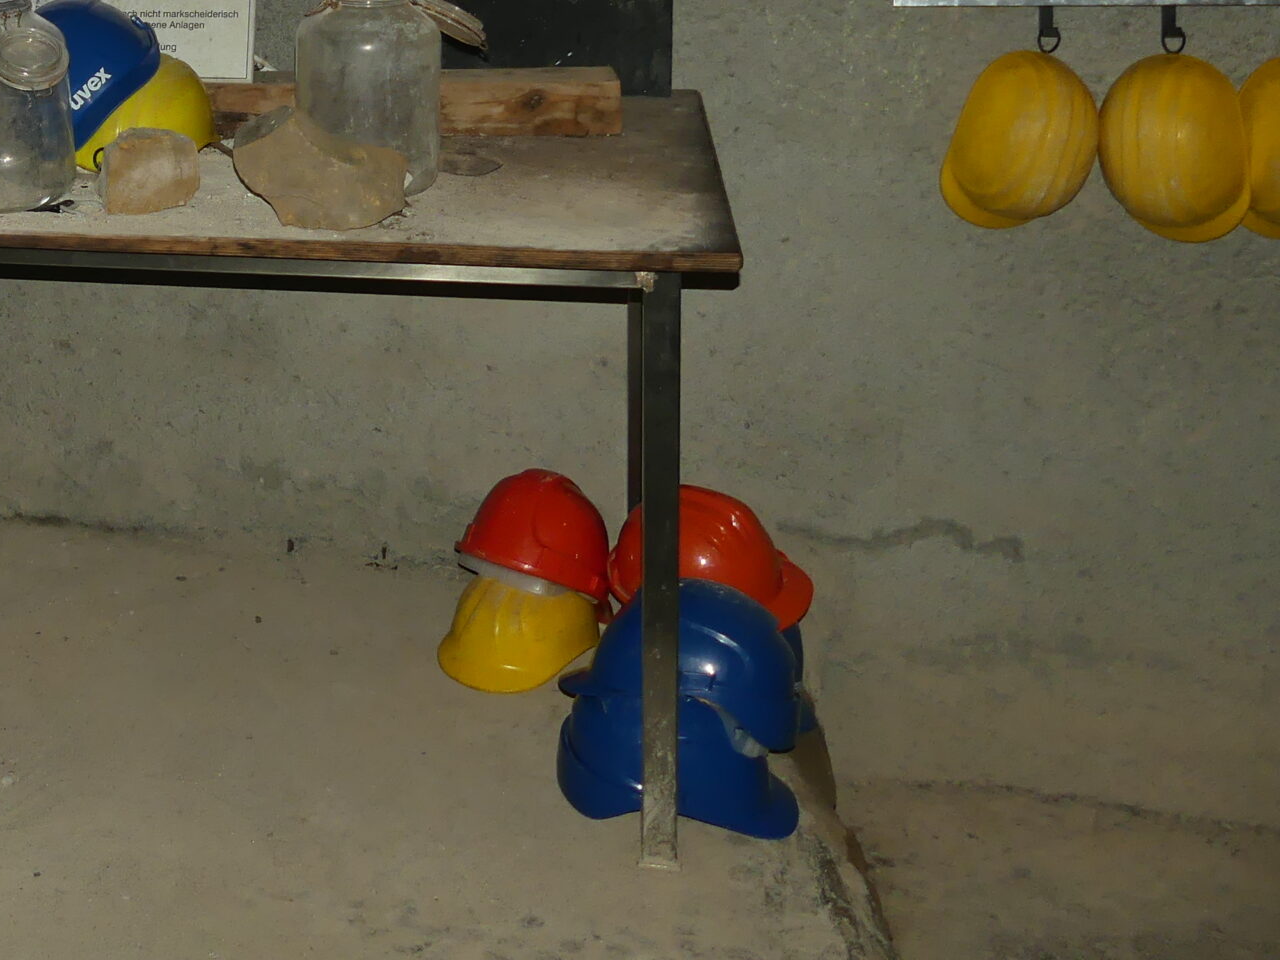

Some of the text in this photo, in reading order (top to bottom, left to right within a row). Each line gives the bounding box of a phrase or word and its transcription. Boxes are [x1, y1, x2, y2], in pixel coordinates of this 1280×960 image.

[140, 10, 161, 18] nicht
[163, 10, 239, 18] markscheiderisch
[169, 20, 206, 31] Anlagen
[70, 66, 113, 111] uvex
